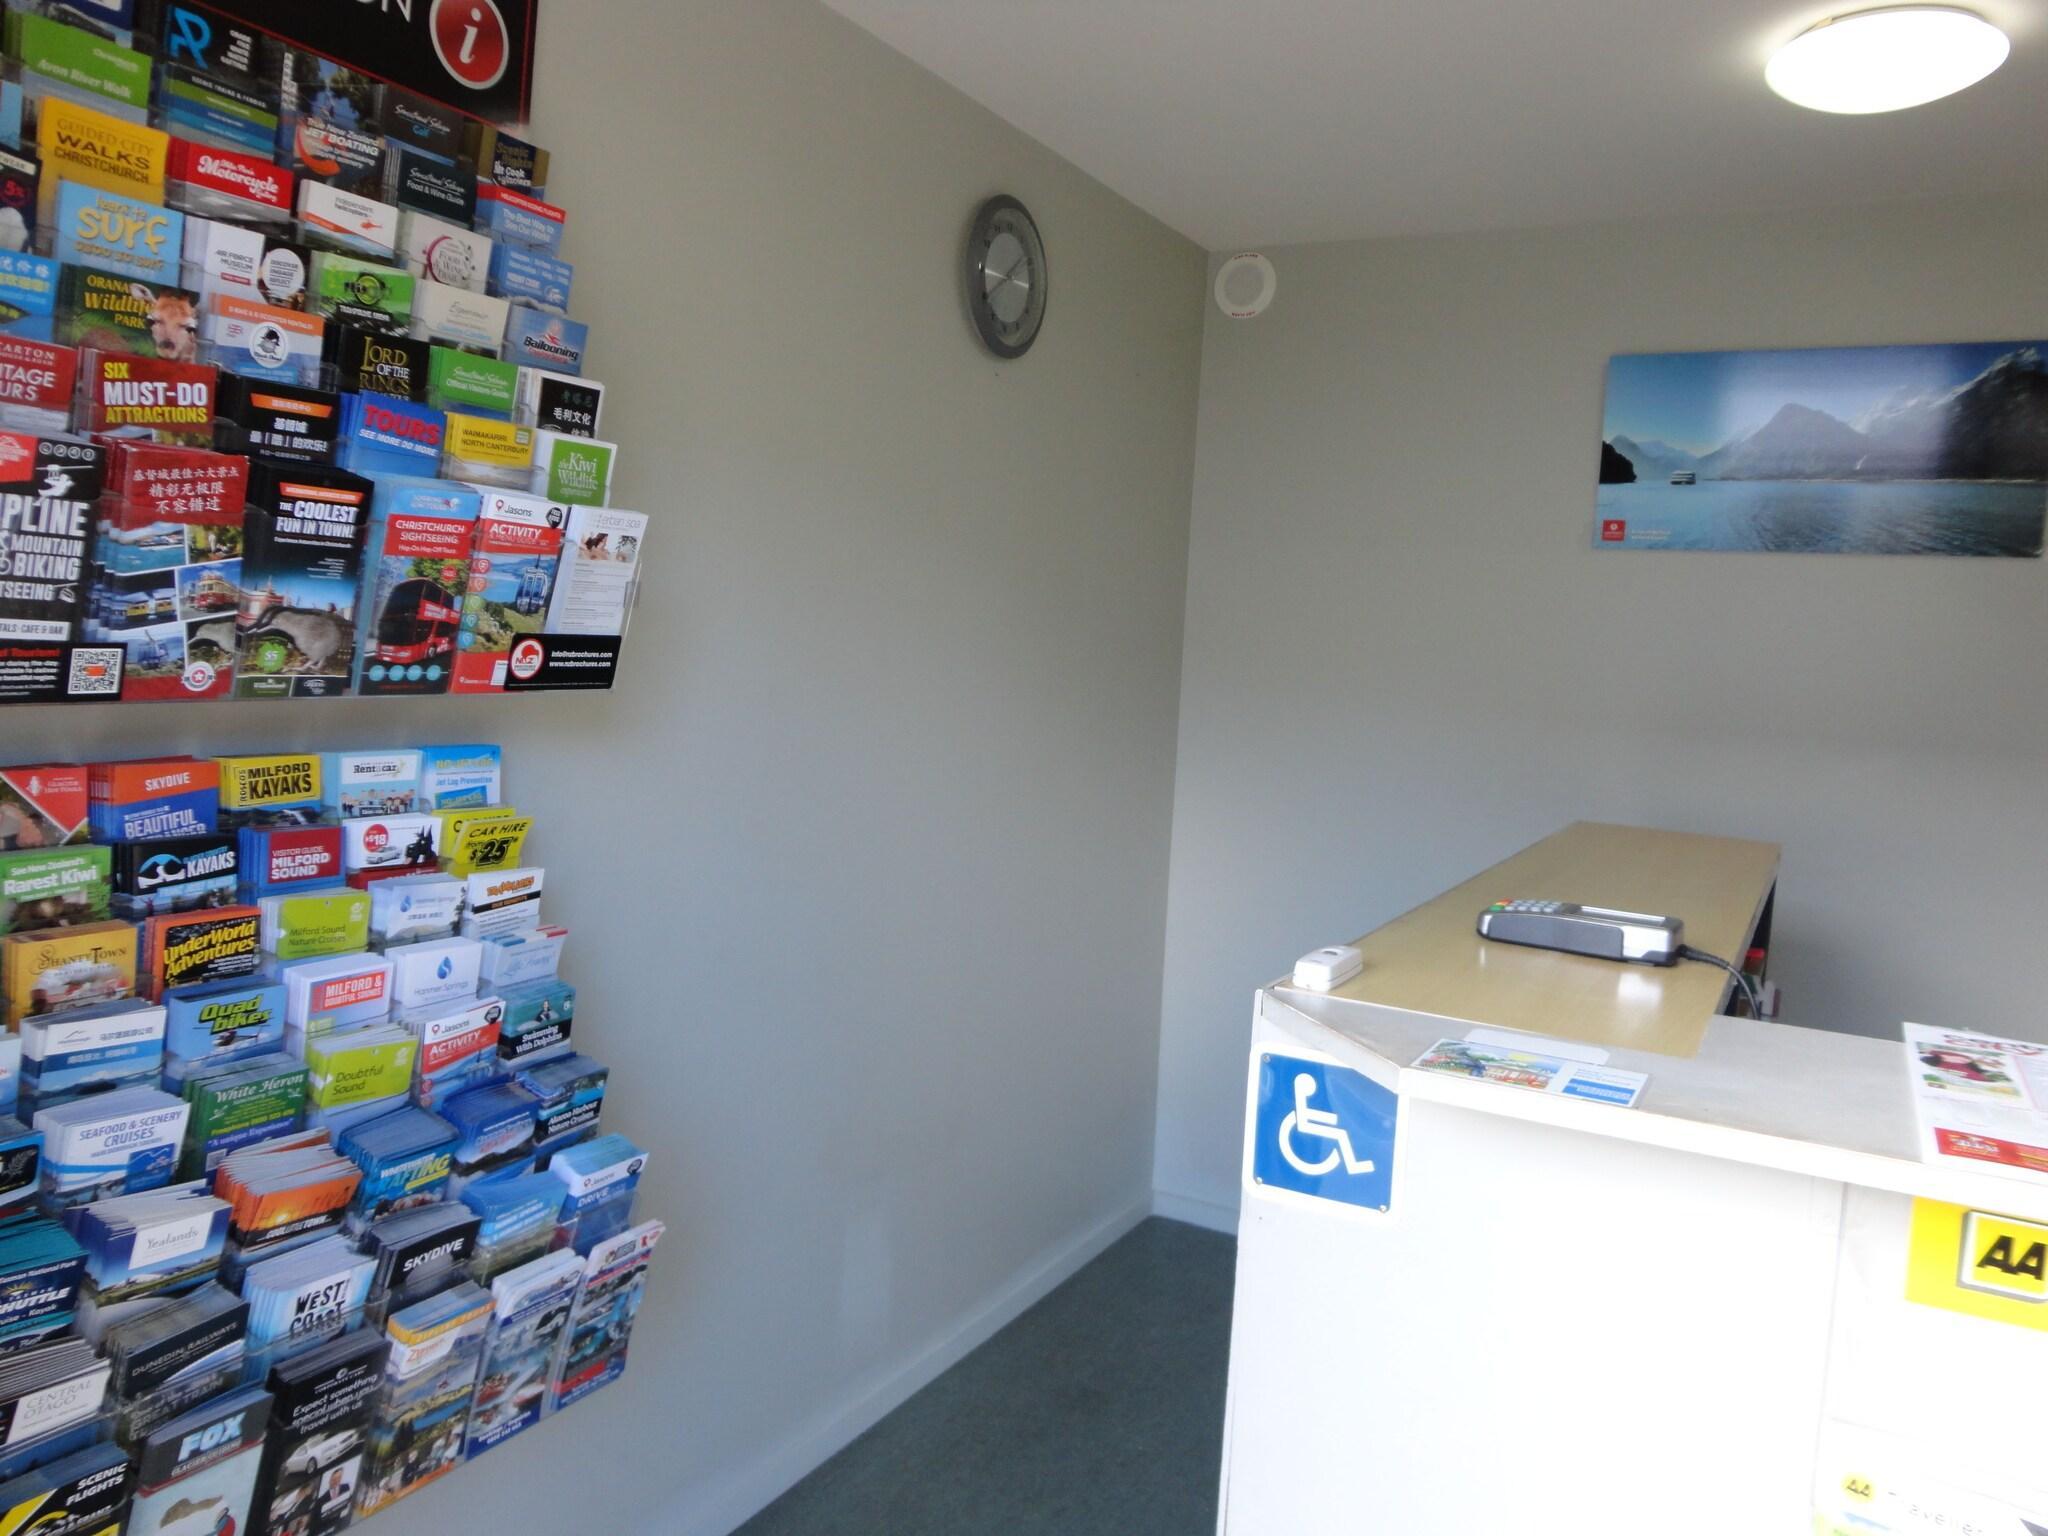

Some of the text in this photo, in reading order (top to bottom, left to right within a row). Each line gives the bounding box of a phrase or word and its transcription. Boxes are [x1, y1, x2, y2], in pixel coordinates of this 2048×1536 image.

[57, 132, 150, 169] WALKS
[327, 134, 380, 156] BOATING
[54, 147, 150, 184] CHRISTCHURCH
[198, 155, 279, 194] Motorcycle
[86, 274, 131, 294] ORANA
[113, 313, 146, 329] PARK
[0, 342, 55, 360] ARTON
[361, 336, 408, 371] LORD
[523, 336, 580, 361] Ballooning
[103, 362, 131, 378] SIX
[377, 363, 411, 379] OF THE
[104, 382, 208, 406] MUST-DO
[360, 373, 409, 394] RINGS
[106, 406, 208, 424] ATTRACTIONS
[364, 404, 441, 446] TOURS
[553, 408, 592, 426] 毛利文化
[359, 428, 377, 440] SEE
[376, 433, 401, 447] MORE
[414, 442, 439, 457] MORE
[462, 438, 529, 456] NORTH CANTERBURY
[569, 451, 598, 474] Kiwi
[557, 468, 599, 490] Wildlife
[0, 493, 90, 538] PLINE
[155, 496, 222, 514] 不容错过
[279, 501, 360, 523] THE COOLEST
[276, 516, 355, 539] FUN IN TOWN!
[395, 520, 466, 534] CHRISTCHURCH
[400, 532, 459, 545] SIGHTSEEING
[489, 523, 542, 540] ACTIVITY
[11, 534, 84, 557] MOUNTAIN
[14, 552, 81, 581] BIKING
[19, 624, 40, 635] CAFE
[248, 763, 311, 780] MILFORD
[353, 764, 377, 774] Rent
[145, 772, 191, 792] SKYDIVE
[249, 774, 312, 799] KAYAKS
[124, 809, 198, 840] BEAUTIFUL
[470, 827, 498, 838] CAR
[499, 822, 529, 834] HIRE
[187, 851, 236, 878] KAYAKS
[271, 852, 330, 869] MILFORD
[271, 864, 319, 880] SOUND
[4, 864, 98, 896] Rarest Kiwi
[287, 934, 347, 947] Nature Cruises
[288, 924, 347, 938] Milford Sound
[165, 936, 255, 980] Adventures
[325, 976, 372, 998] MILFORD
[199, 995, 263, 1024] Quad
[210, 1008, 273, 1036] bikes
[429, 1030, 481, 1058] ACTIVITY
[335, 1065, 384, 1083] Doubtful
[215, 1073, 305, 1104] White Heron
[332, 1080, 366, 1095] Sound
[79, 1110, 182, 1141] SEAFOOD & SCENERY
[103, 1127, 155, 1148] CRUISES
[147, 1226, 199, 1249] Yealands
[402, 1237, 465, 1273] SKYDIVE
[1976, 1234, 2048, 1281] AA
[295, 1279, 346, 1317] WEST
[23, 1394, 78, 1420] OTAGO
[25, 1380, 92, 1411] CENTRAL
[292, 1394, 328, 1418] Expect
[177, 1411, 247, 1462] FOX
[77, 1462, 128, 1491] SCENIC
[65, 1474, 126, 1508] FLIGHTS
